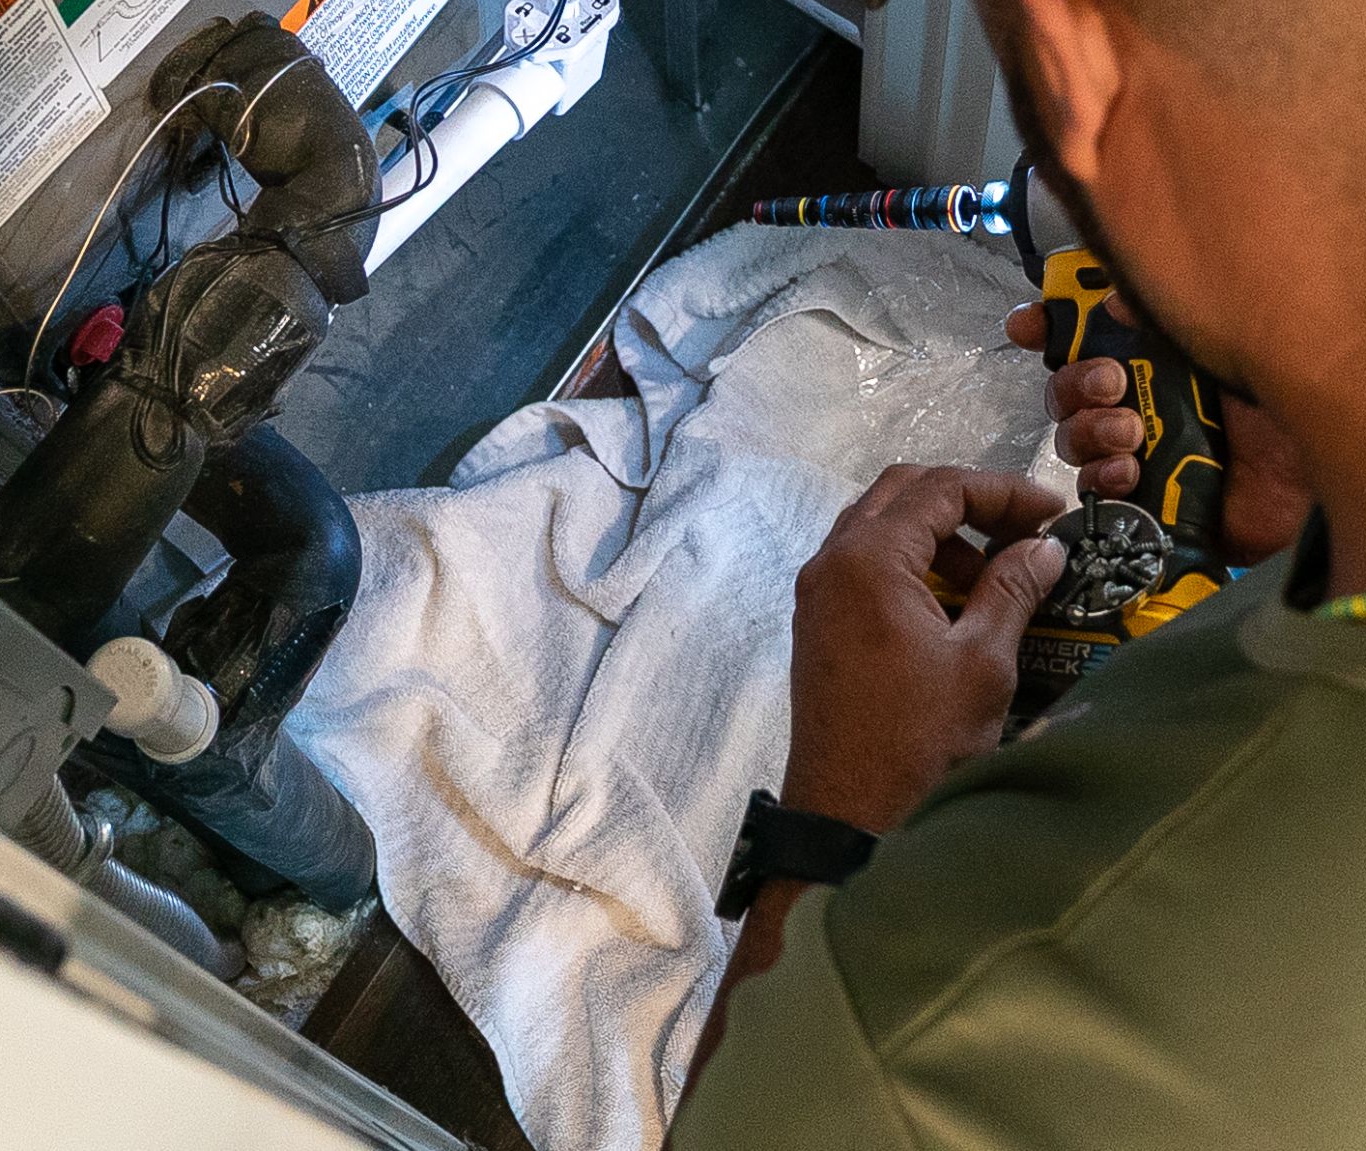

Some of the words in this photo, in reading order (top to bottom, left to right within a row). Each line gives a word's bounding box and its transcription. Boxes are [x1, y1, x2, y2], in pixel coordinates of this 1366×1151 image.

[318, 26, 329, 39] Of
[326, 23, 351, 52] devices
[349, 2, 370, 26] which
[327, 54, 343, 73] with
[341, 42, 354, 57] the
[352, 17, 376, 45] specific
[329, 49, 338, 60] in
[336, 37, 349, 52] the
[338, 48, 369, 83] minimum
[368, 30, 385, 50] room
[384, 13, 400, 32] areas
[398, 3, 407, 14] at
[339, 52, 357, 72] room
[355, 37, 370, 53] area
[368, 0, 401, 39] (operating
[346, 69, 370, 97] ECTION
[368, 42, 393, 72] SYSTEM
[362, 58, 390, 91] powered
[387, 36, 409, 62] except
[407, 26, 416, 38] for
[1135, 363, 1157, 442] BRUSHLESS
[1018, 657, 1082, 676] TACK
[1019, 642, 1091, 659] OWER
